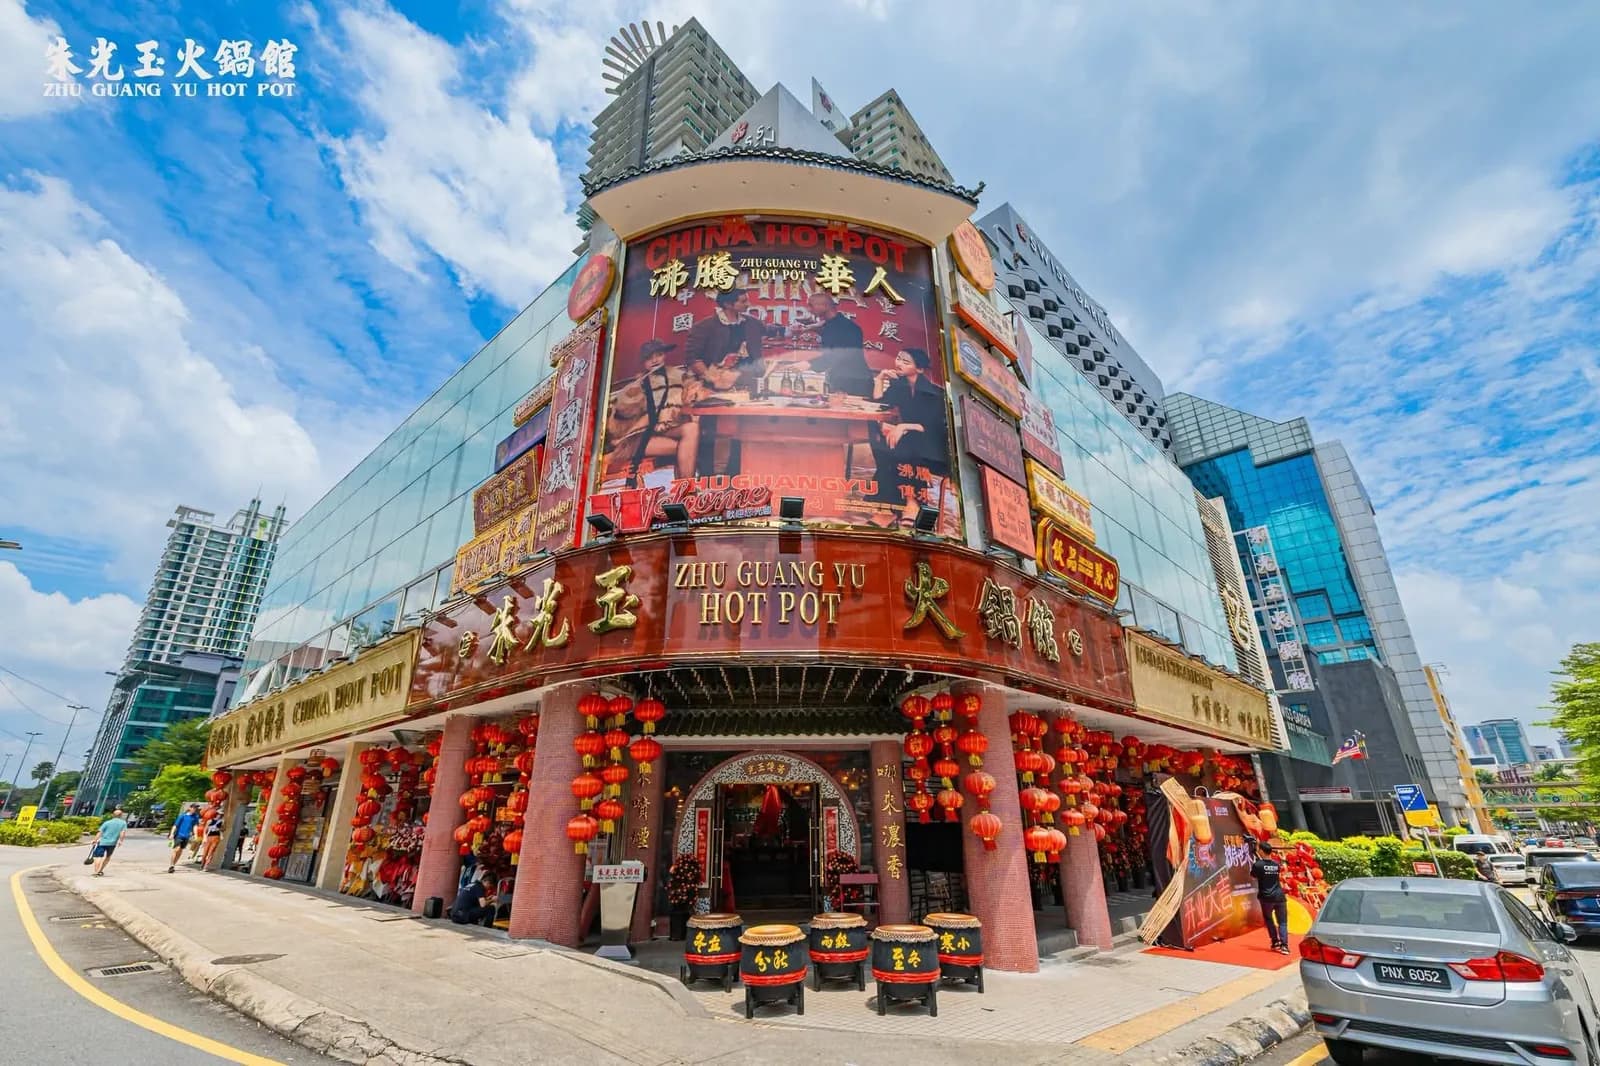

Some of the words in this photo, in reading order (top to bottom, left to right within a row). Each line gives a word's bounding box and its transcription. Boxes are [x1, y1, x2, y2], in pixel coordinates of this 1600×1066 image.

[645, 222, 757, 270] CHINA
[765, 223, 908, 273] HOTPOT
[649, 250, 740, 299] 沸騰
[815, 254, 905, 304] 華人
[740, 258, 763, 268] ZHU
[765, 258, 801, 268] GUANG
[803, 260, 818, 270] YU
[751, 269, 779, 280] HOT
[782, 269, 807, 281] POT
[674, 561, 727, 588] ZHU
[737, 561, 825, 588] GUANG
[833, 562, 866, 588] YU
[699, 591, 767, 624] HOT
[778, 591, 841, 624] POT
[1380, 965, 1404, 980] PNX
[1409, 969, 1442, 983] 6052
